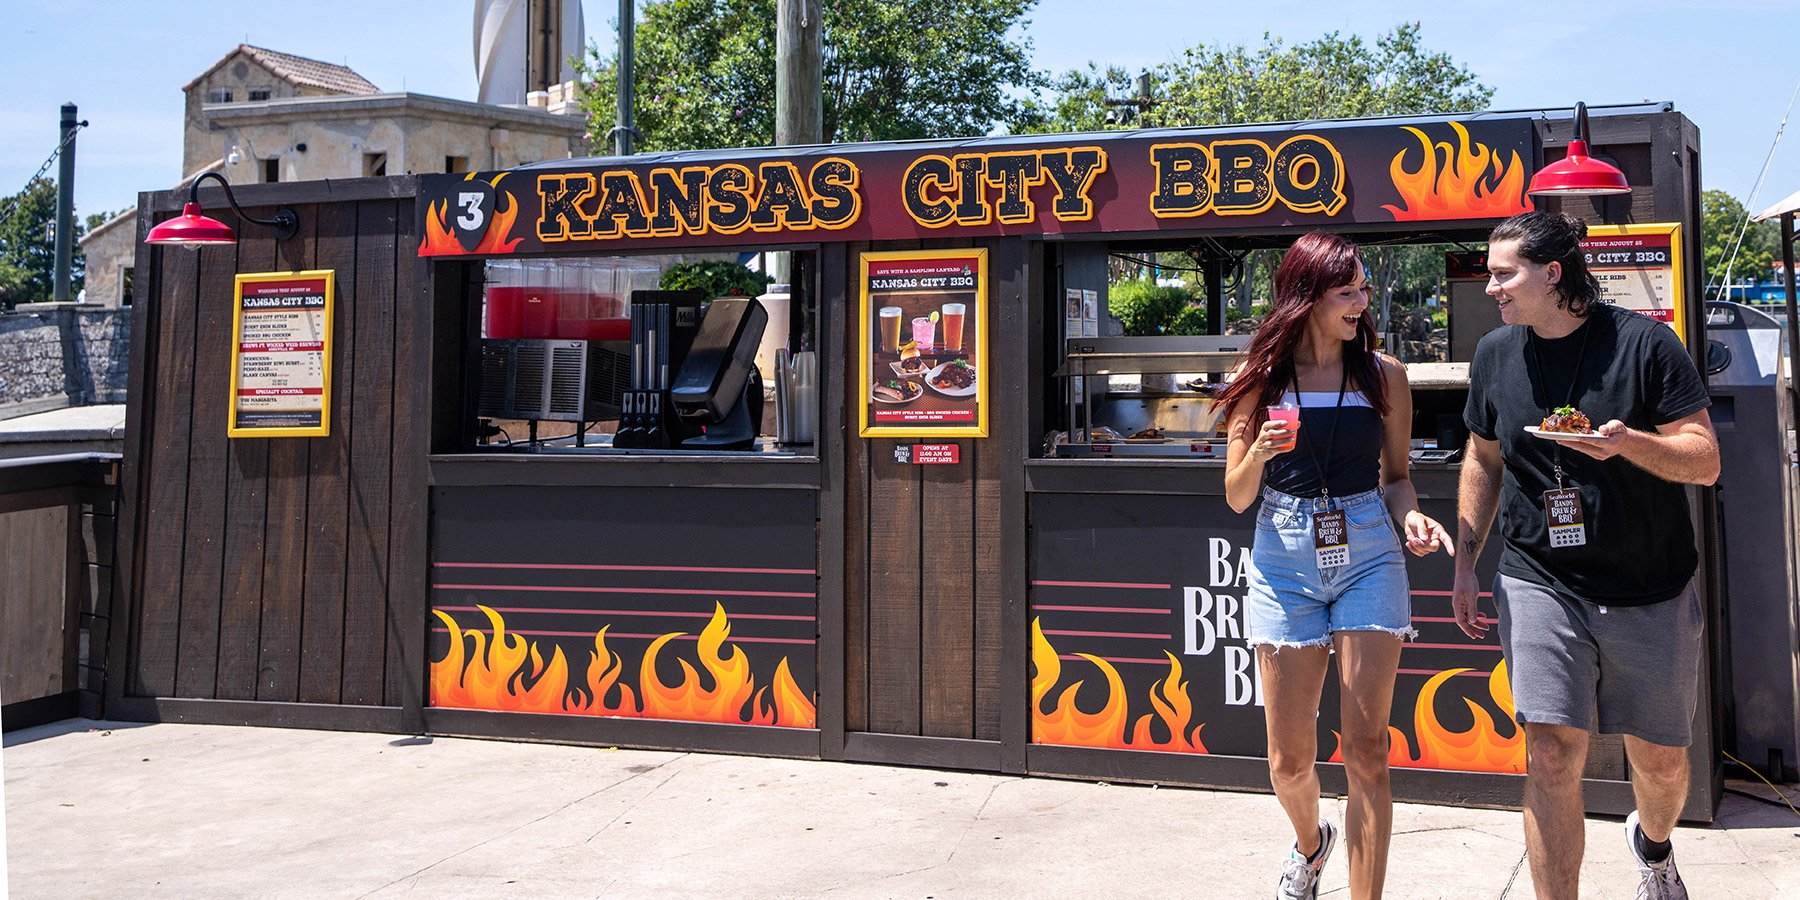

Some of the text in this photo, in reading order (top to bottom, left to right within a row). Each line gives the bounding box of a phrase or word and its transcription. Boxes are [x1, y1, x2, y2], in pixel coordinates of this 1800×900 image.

[536, 134, 1347, 242] KANSAS CITY BBQ
[457, 192, 484, 231] 3
[1597, 252, 1631, 263] CITY
[1636, 252, 1666, 262] BBQ
[872, 277, 974, 288] KANSAS CITY BBQ
[244, 296, 324, 307] KANSAS CITY BBQ
[1552, 507, 1569, 517] BREW
[1558, 514, 1574, 524] BBQ
[1318, 528, 1335, 539] BREW
[1325, 535, 1339, 544] BBQ
[1319, 548, 1346, 556] SAMPLER
